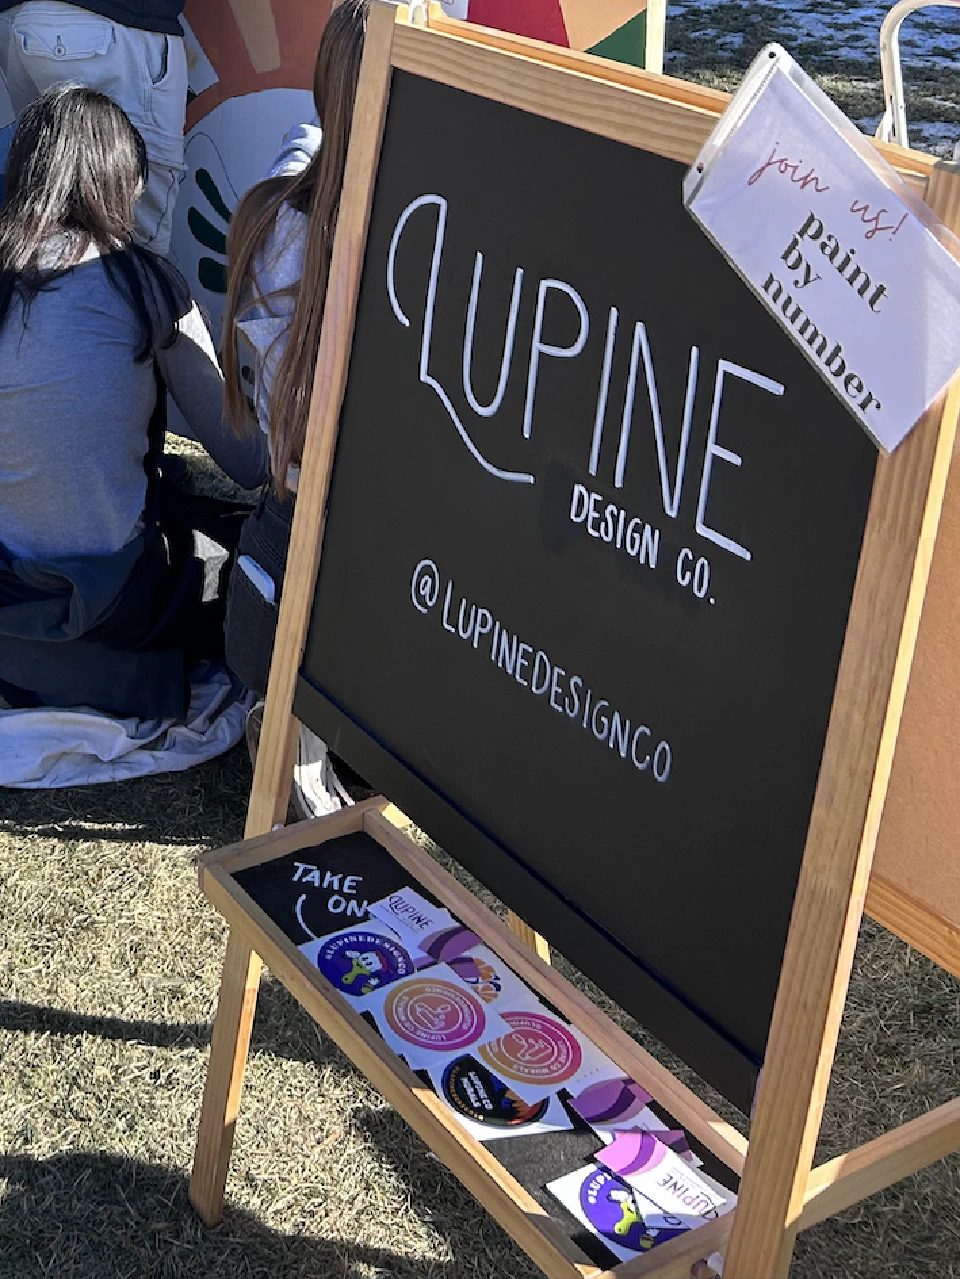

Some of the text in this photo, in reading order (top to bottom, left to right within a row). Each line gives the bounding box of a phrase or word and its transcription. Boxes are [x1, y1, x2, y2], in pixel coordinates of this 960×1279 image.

[747, 141, 909, 241] join us!
[780, 234, 822, 288] by
[797, 209, 888, 313] paint
[386, 193, 785, 561] LUPINE
[760, 271, 881, 413] number
[570, 483, 715, 605] DESIGN CO.
[410, 558, 673, 783] @LUPINEDESIGNCO
[292, 861, 363, 894] TAKE
[327, 893, 368, 917] ON
